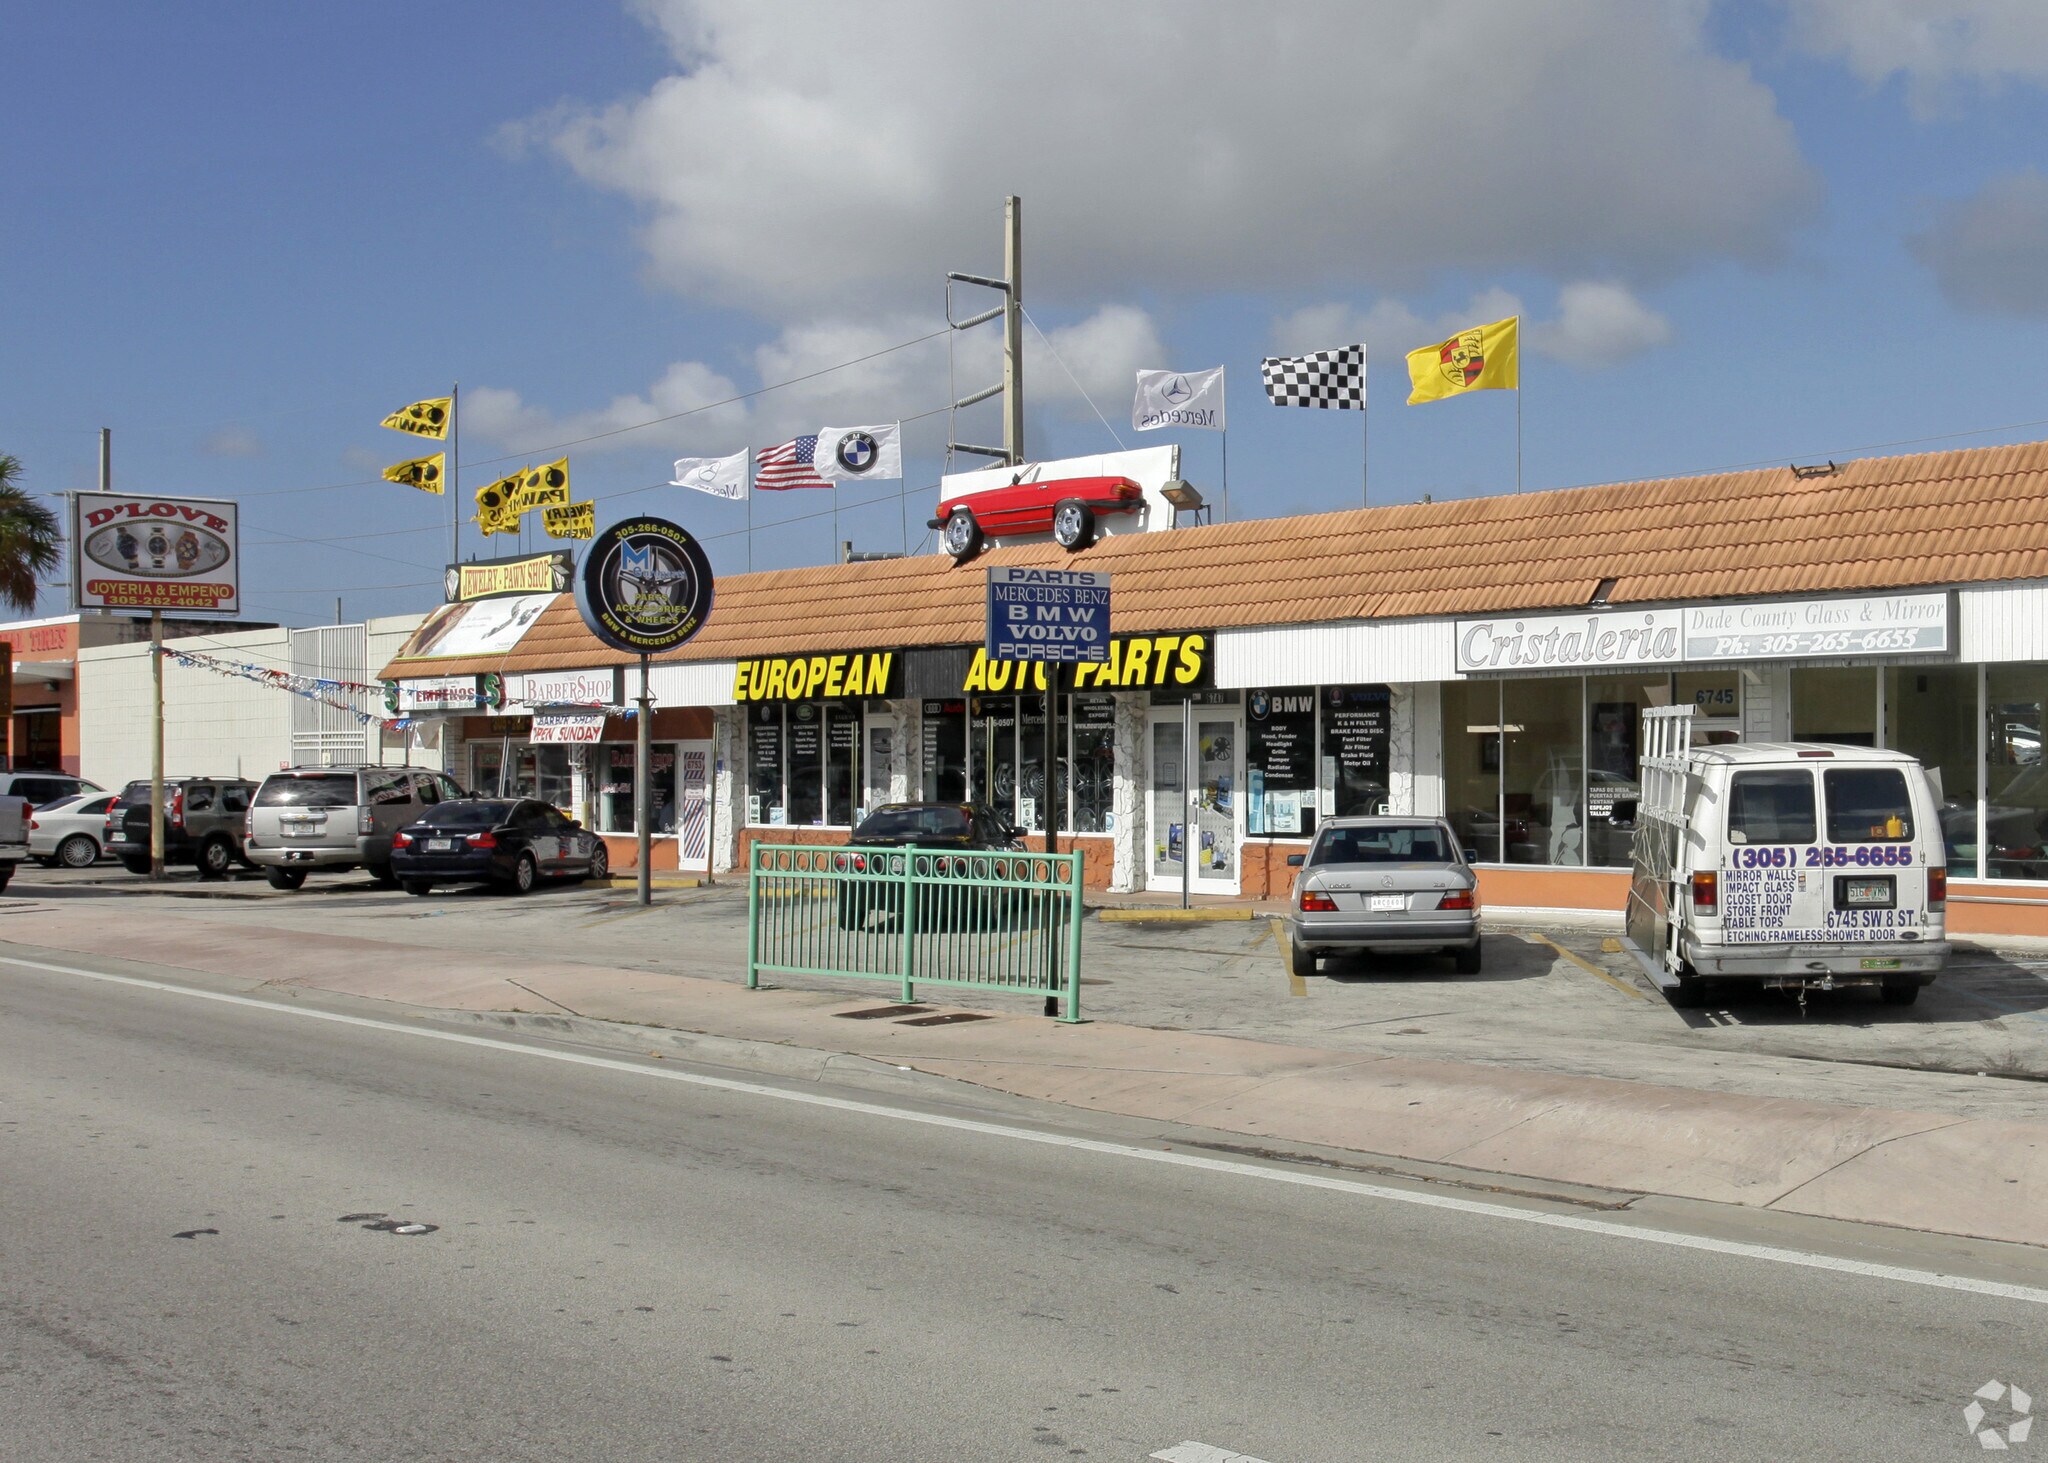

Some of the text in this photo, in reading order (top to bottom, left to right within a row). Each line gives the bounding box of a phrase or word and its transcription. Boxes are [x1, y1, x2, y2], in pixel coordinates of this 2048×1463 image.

[85, 503, 229, 534] D'LOVE
[614, 523, 687, 544] 305-266-0507
[463, 568, 499, 597] JEWELRY
[503, 564, 526, 590] PAWN
[527, 559, 550, 588] SHOP
[1008, 568, 1096, 585] PARTS
[91, 582, 230, 598] JOYERIA & EMPEÑO
[634, 593, 669, 602] PARTS
[995, 586, 1109, 605] MERCEDES BENZ
[108, 595, 213, 607] 305-262-4042
[614, 604, 688, 614] ACCESSORIES
[625, 616, 679, 625] & WHEELS
[1692, 599, 1945, 630] Dade County Glass & Mirror
[601, 612, 620, 632] BMW
[628, 635, 678, 646] MERCEDES
[677, 617, 698, 637] BENZ
[1007, 624, 1098, 642] VOLVO
[1461, 614, 1678, 667] Cristaleria
[1712, 627, 1919, 656] Ph: 305-265-6655
[998, 642, 1105, 660] PORSCHE
[733, 652, 892, 701] EUROPEAN
[963, 647, 1060, 692] AU
[416, 685, 475, 703] EMPEÑOS
[1695, 688, 1734, 705] 6745
[1271, 695, 1313, 713] BMW
[558, 726, 602, 742] SUNDAY
[1732, 846, 1913, 869] (305) 265-6655
[1725, 869, 1797, 882] MIRROR WALLS
[1725, 881, 1795, 894] IMPACT GLASS
[1726, 893, 1793, 905] CLOSET DOOR
[1726, 904, 1791, 917] STORE FRONT
[1827, 910, 1918, 928] 6745 SW 8 ST.
[1726, 916, 1783, 928] TABLE TOPS
[1826, 929, 1865, 941] SHOWER
[1869, 929, 1895, 940] DOOR
